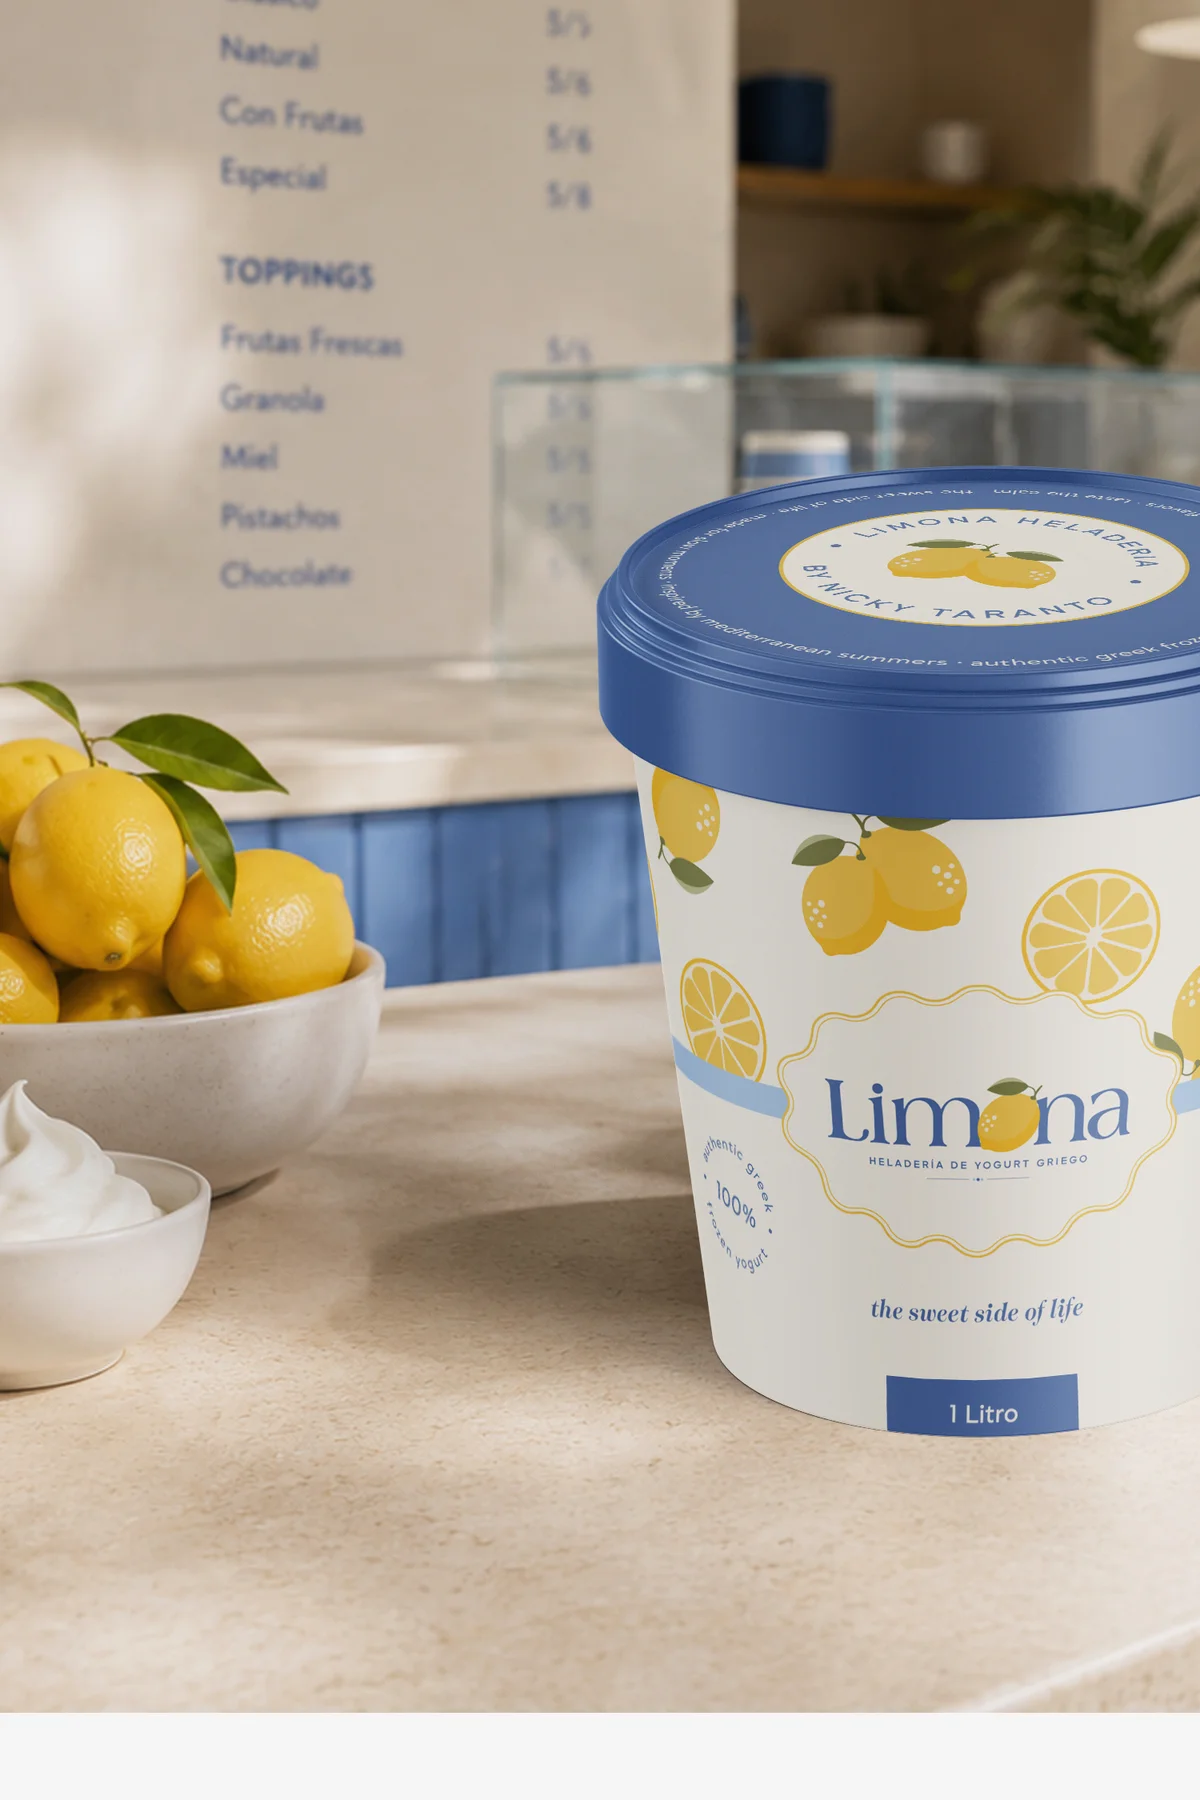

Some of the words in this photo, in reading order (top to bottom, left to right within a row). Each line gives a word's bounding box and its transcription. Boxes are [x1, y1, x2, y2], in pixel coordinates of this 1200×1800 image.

[220, 34, 319, 70] Natural
[219, 93, 276, 125] Con
[285, 100, 364, 135] Frutas
[220, 156, 327, 193] Especial
[219, 255, 374, 292] TOPPINGS
[220, 323, 301, 354] Frutas
[310, 325, 404, 356] Frescas
[220, 382, 325, 412] Granola
[220, 443, 278, 470] Miel
[220, 500, 341, 531] Pistachos
[853, 516, 997, 538] LIMONA
[1017, 517, 1159, 567] HELADERIA
[220, 560, 353, 589] Chocolate
[802, 564, 832, 579] BY
[817, 582, 915, 612] NICKY
[932, 596, 1113, 619] TARANTO
[658, 582, 694, 611] inspired
[700, 614, 832, 656] mediterranean
[837, 651, 948, 666] summers
[970, 656, 1090, 667] authentic
[1095, 646, 1156, 662] greek
[702, 1136, 744, 1163] authentic
[745, 1163, 774, 1212] greek
[868, 1156, 944, 1170] HELADERÍA
[950, 1160, 968, 1170] DE
[974, 1159, 1030, 1170] YOGURT
[1036, 1154, 1088, 1168] GRIEGO
[716, 1179, 756, 1229] 100%
[706, 1201, 732, 1258] frozen
[735, 1248, 768, 1274] yogurt
[871, 1298, 903, 1320] the
[908, 1305, 969, 1323] sweet
[974, 1302, 1019, 1323] side
[1024, 1299, 1047, 1326] of
[1049, 1296, 1084, 1324] life
[949, 1404, 957, 1424] 1
[965, 1403, 1019, 1424] Litro
